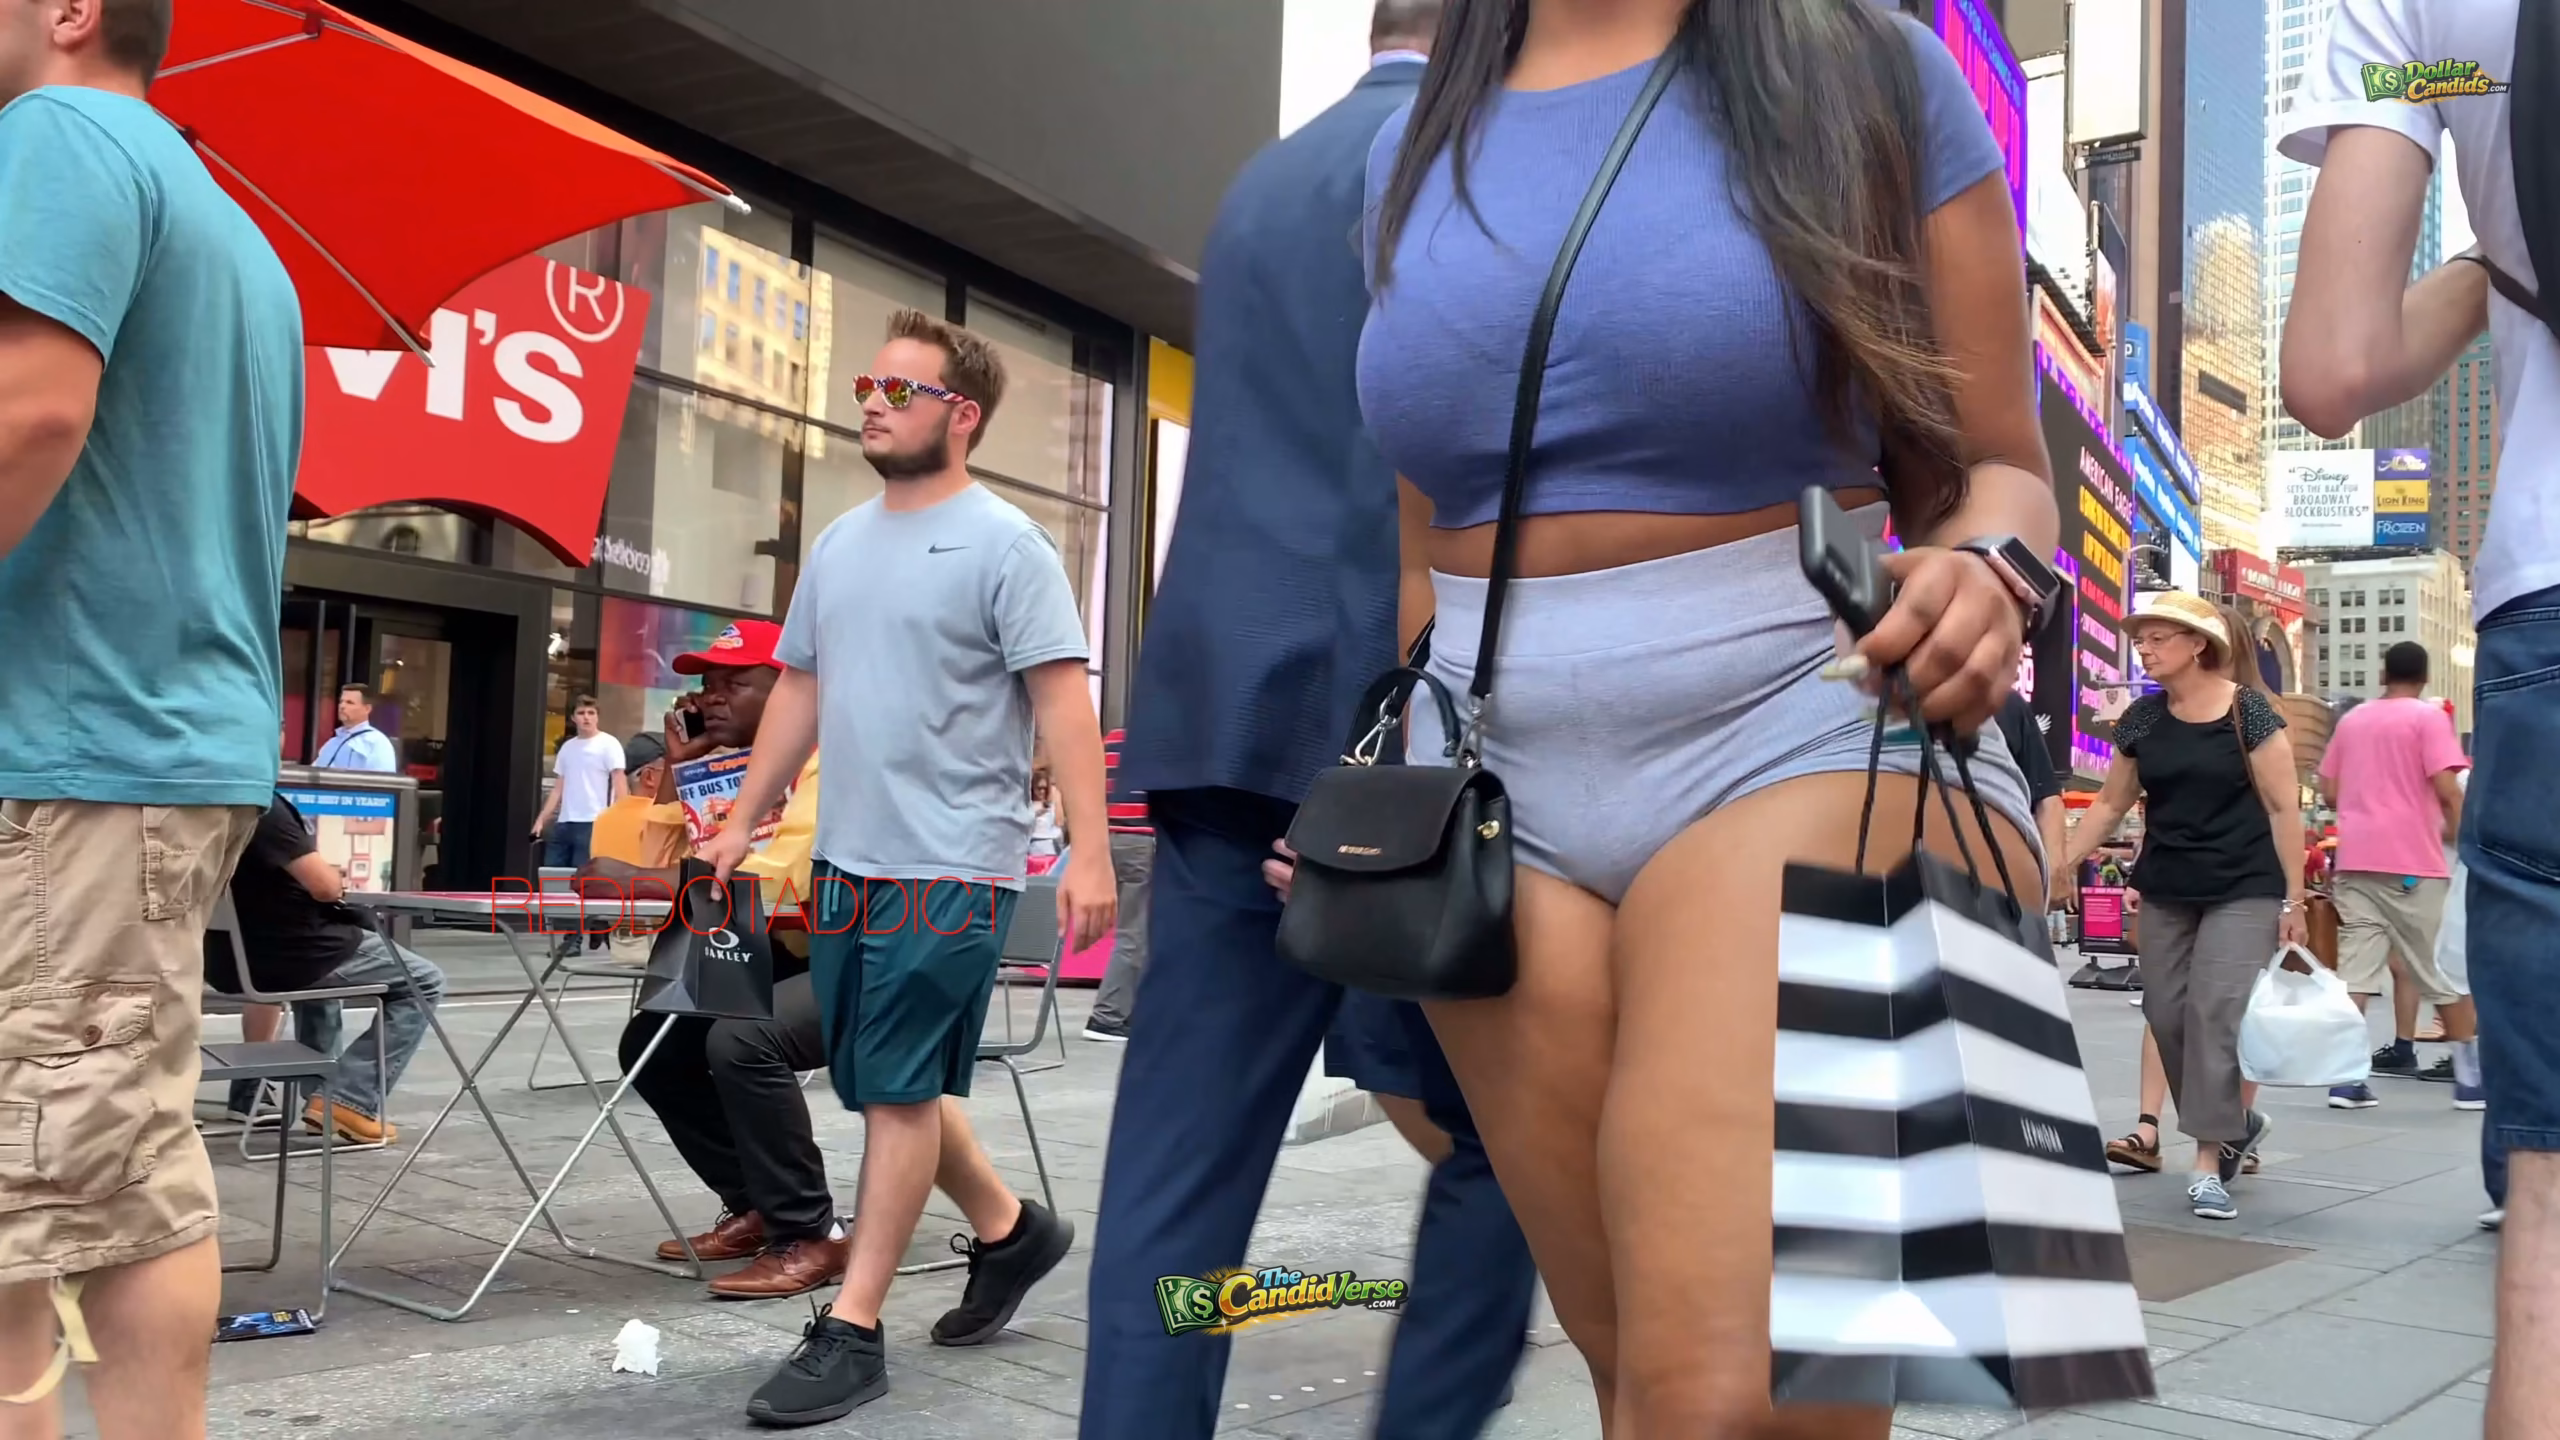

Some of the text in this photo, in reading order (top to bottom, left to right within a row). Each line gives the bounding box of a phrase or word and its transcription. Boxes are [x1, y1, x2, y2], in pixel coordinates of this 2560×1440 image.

[2079, 445, 2114, 504] AMERICAN
[2307, 485, 2321, 493] THE
[2325, 484, 2340, 493] BAR
[2293, 494, 2351, 506] BROADWAY
[2377, 495, 2425, 507] LION KING
[2376, 520, 2425, 535] FROZEN
[699, 780, 723, 797] BUS
[726, 775, 745, 790] TO
[704, 946, 751, 963] OAKLEY
